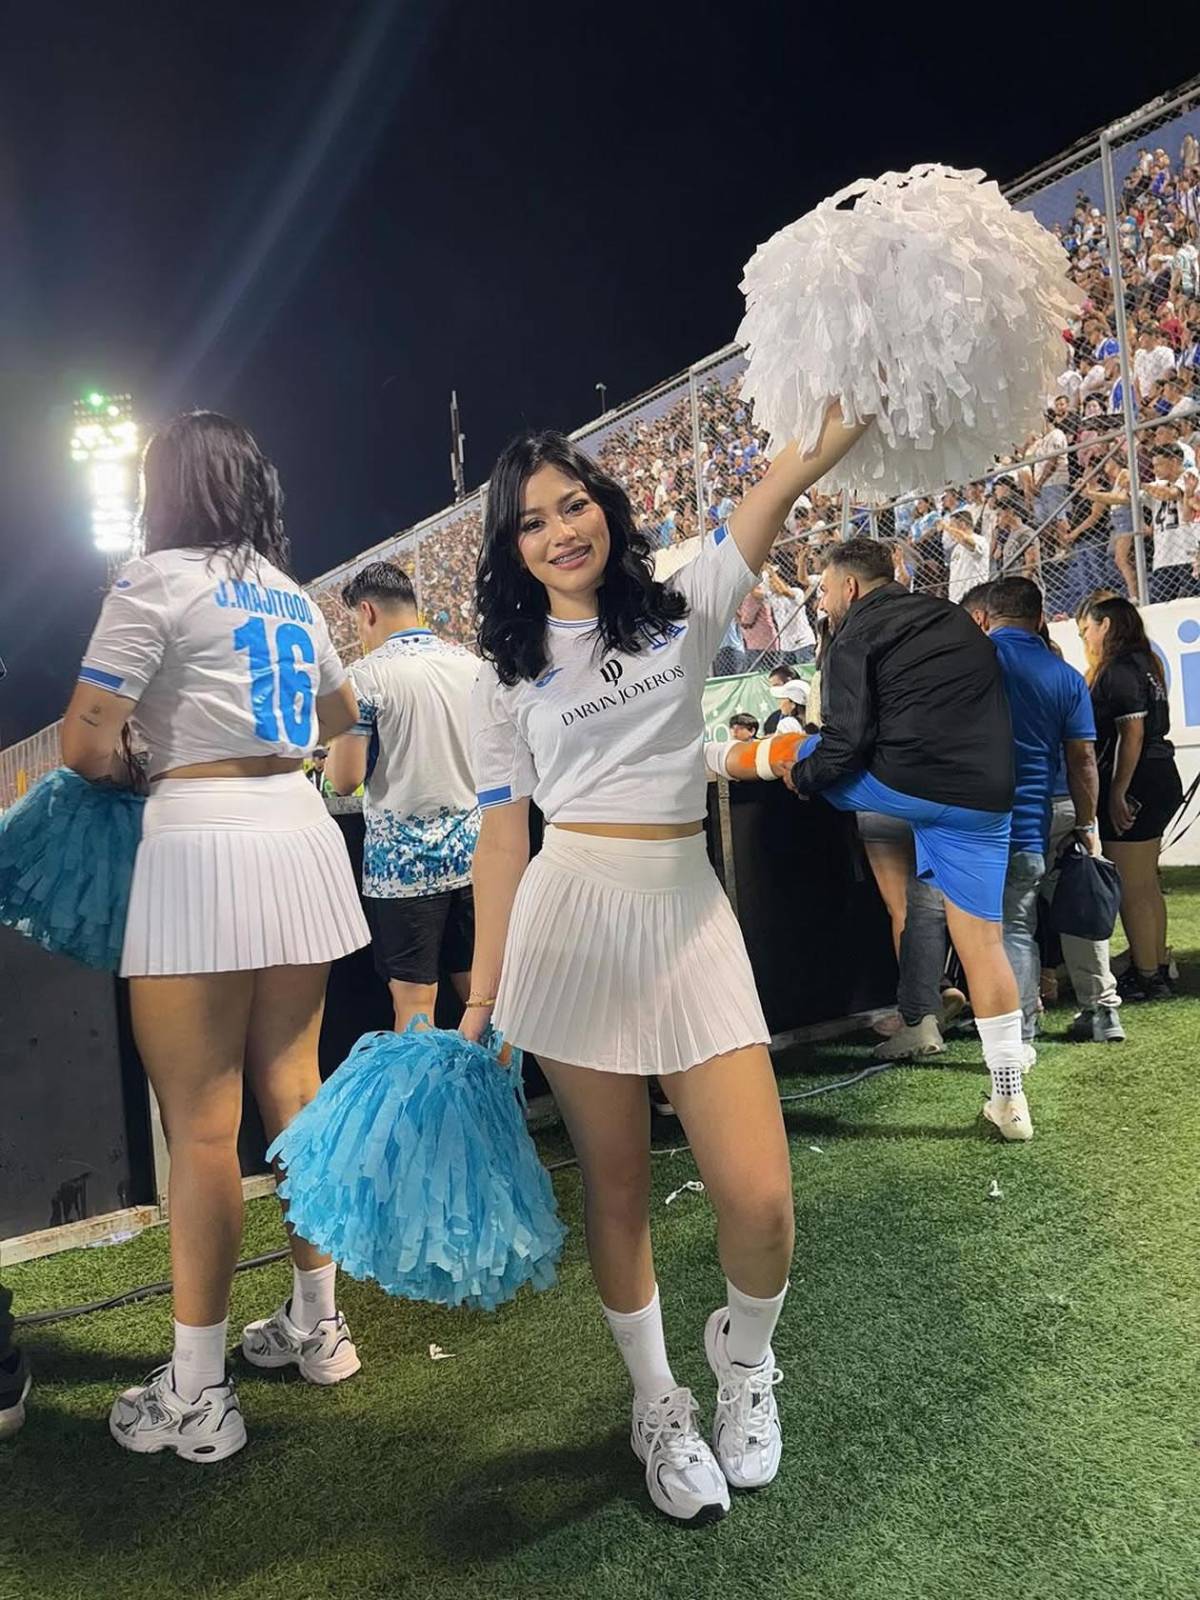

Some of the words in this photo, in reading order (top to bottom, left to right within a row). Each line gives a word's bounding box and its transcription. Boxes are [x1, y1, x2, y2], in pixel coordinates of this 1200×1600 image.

[233, 615, 315, 748] 16
[560, 693, 617, 726] DARVIN
[618, 665, 685, 705] JOYEROS
